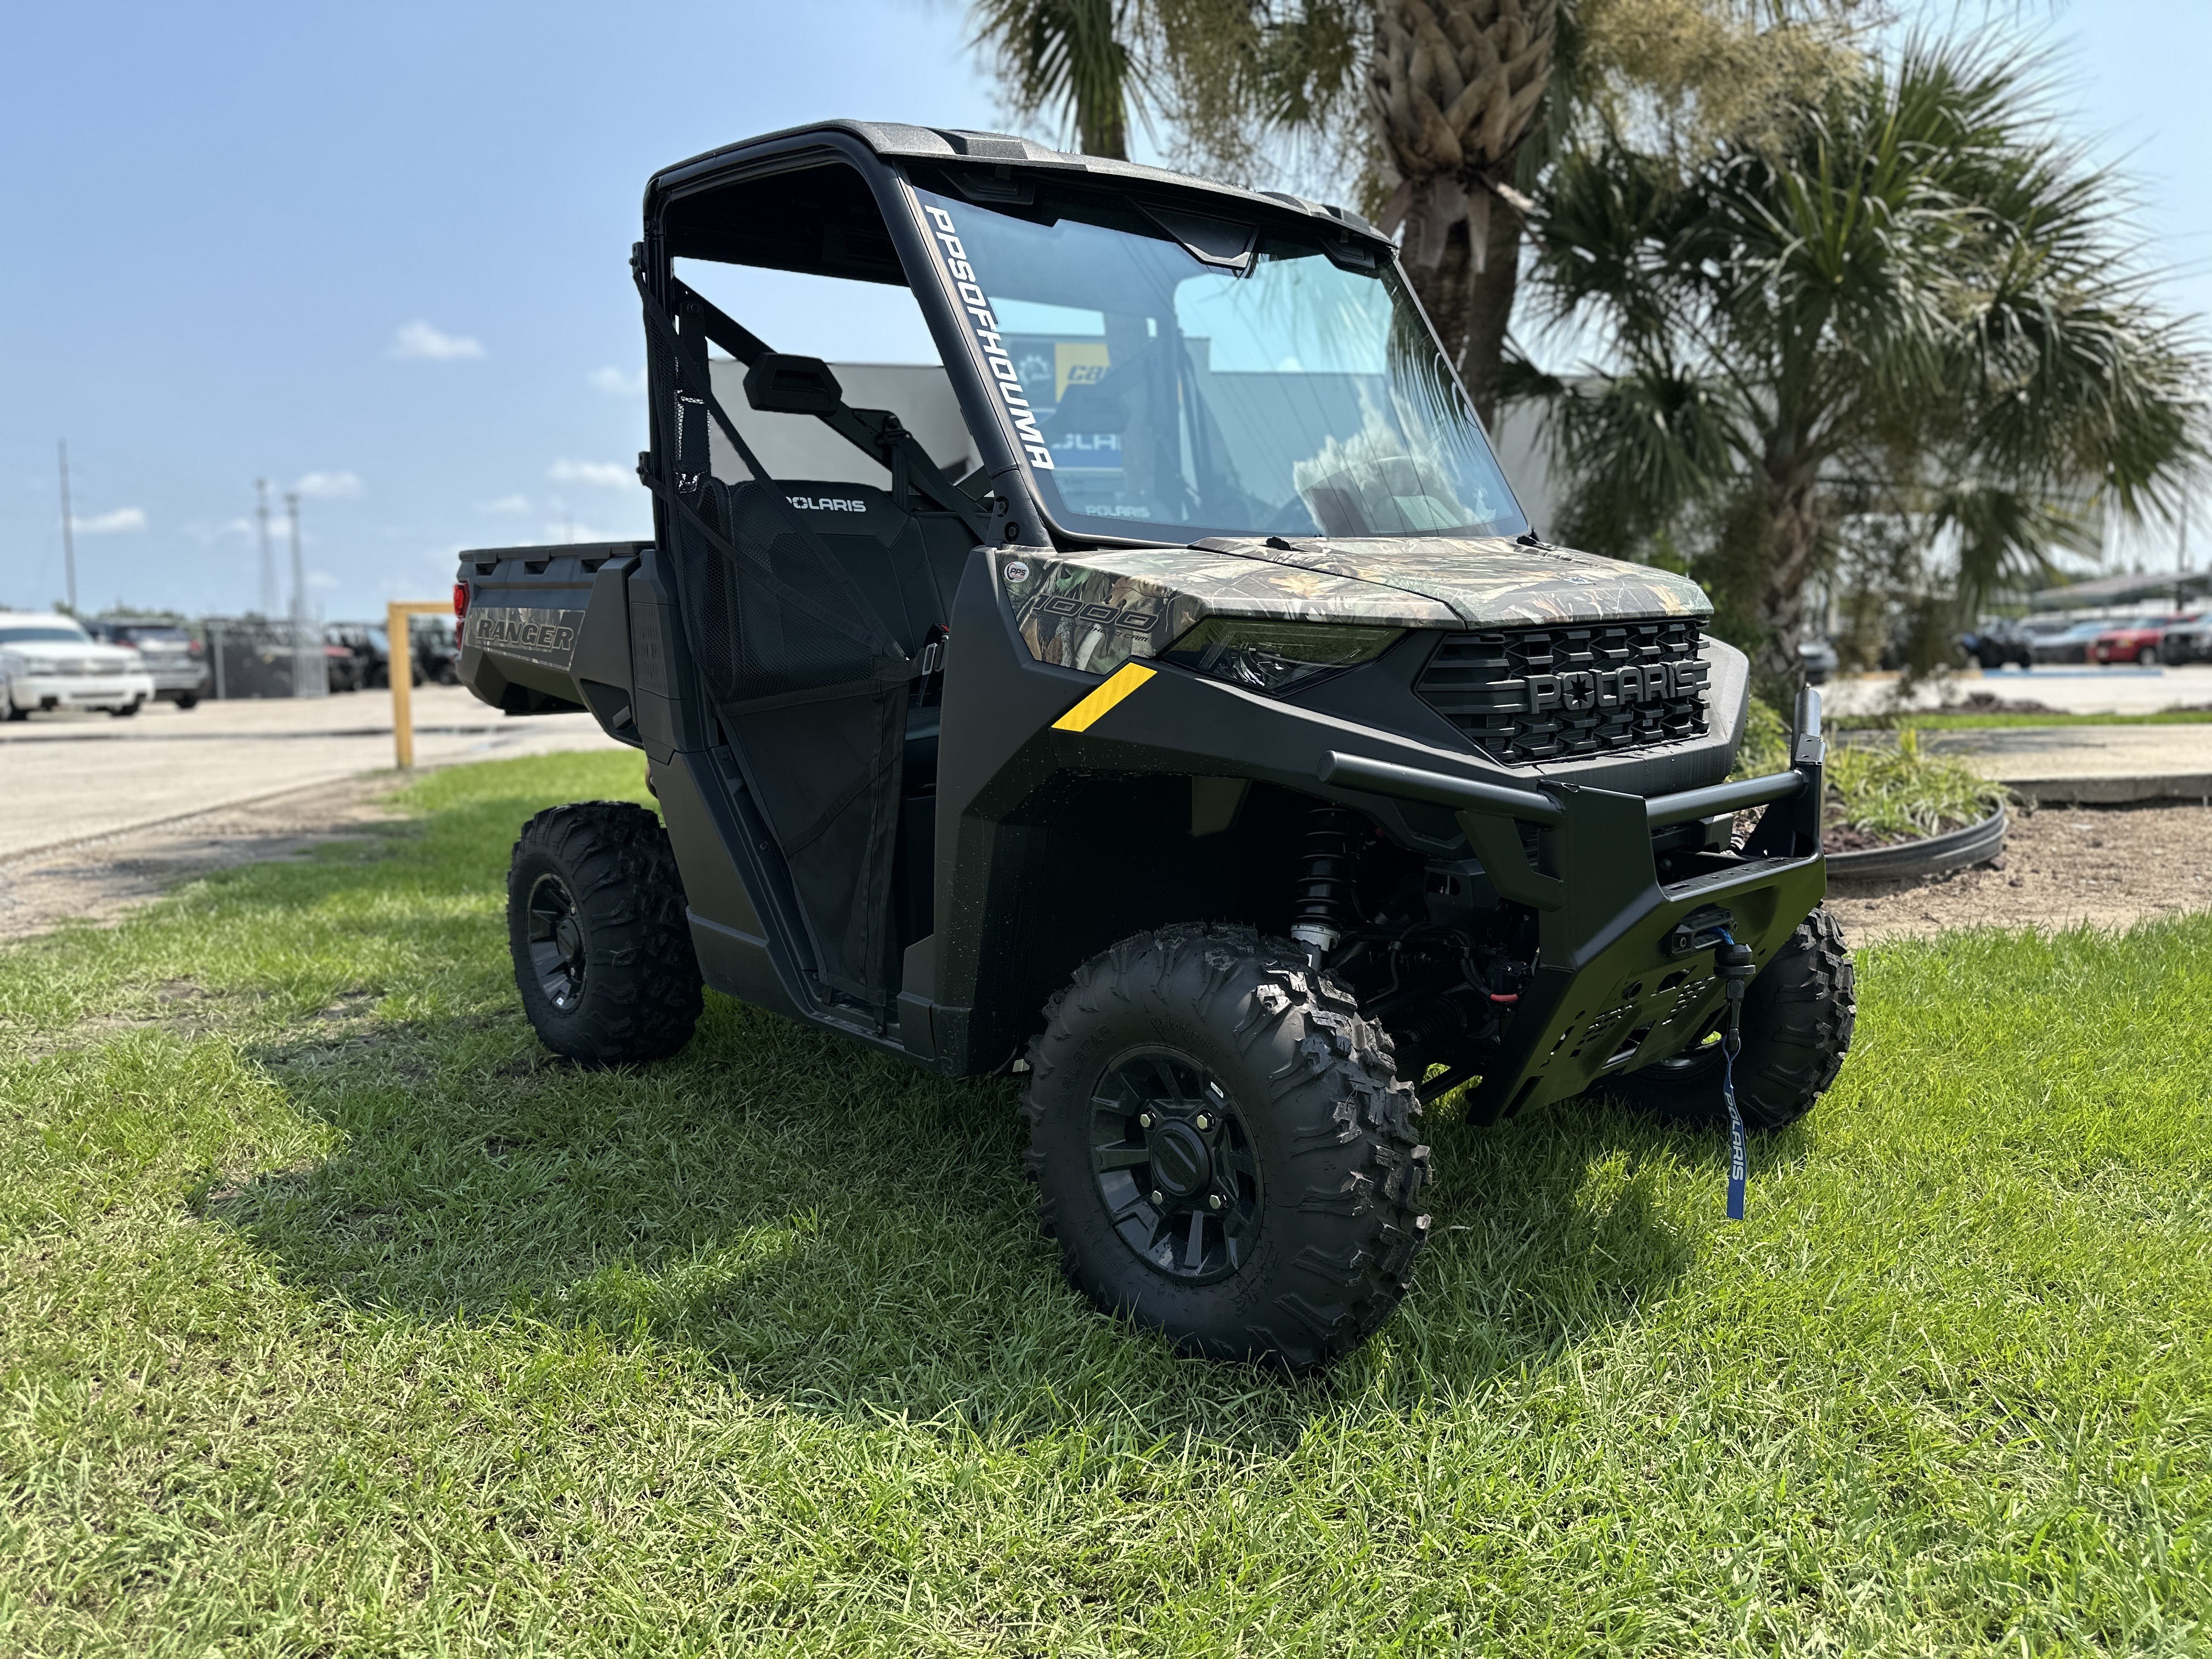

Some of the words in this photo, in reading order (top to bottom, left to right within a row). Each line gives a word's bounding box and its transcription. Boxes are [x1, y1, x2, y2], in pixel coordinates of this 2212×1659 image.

[924, 205, 1054, 470] PPSOFHOUMA
[1085, 505, 1150, 517] POLARIS
[477, 619, 574, 651] RANGER
[1033, 593, 1159, 631] 1000
[1124, 633, 1148, 642] CAM
[1524, 659, 1696, 713] POLARIS
[1057, 1024, 1114, 1121] CARLSTAR
[1724, 1092, 1743, 1181] POLARIS
